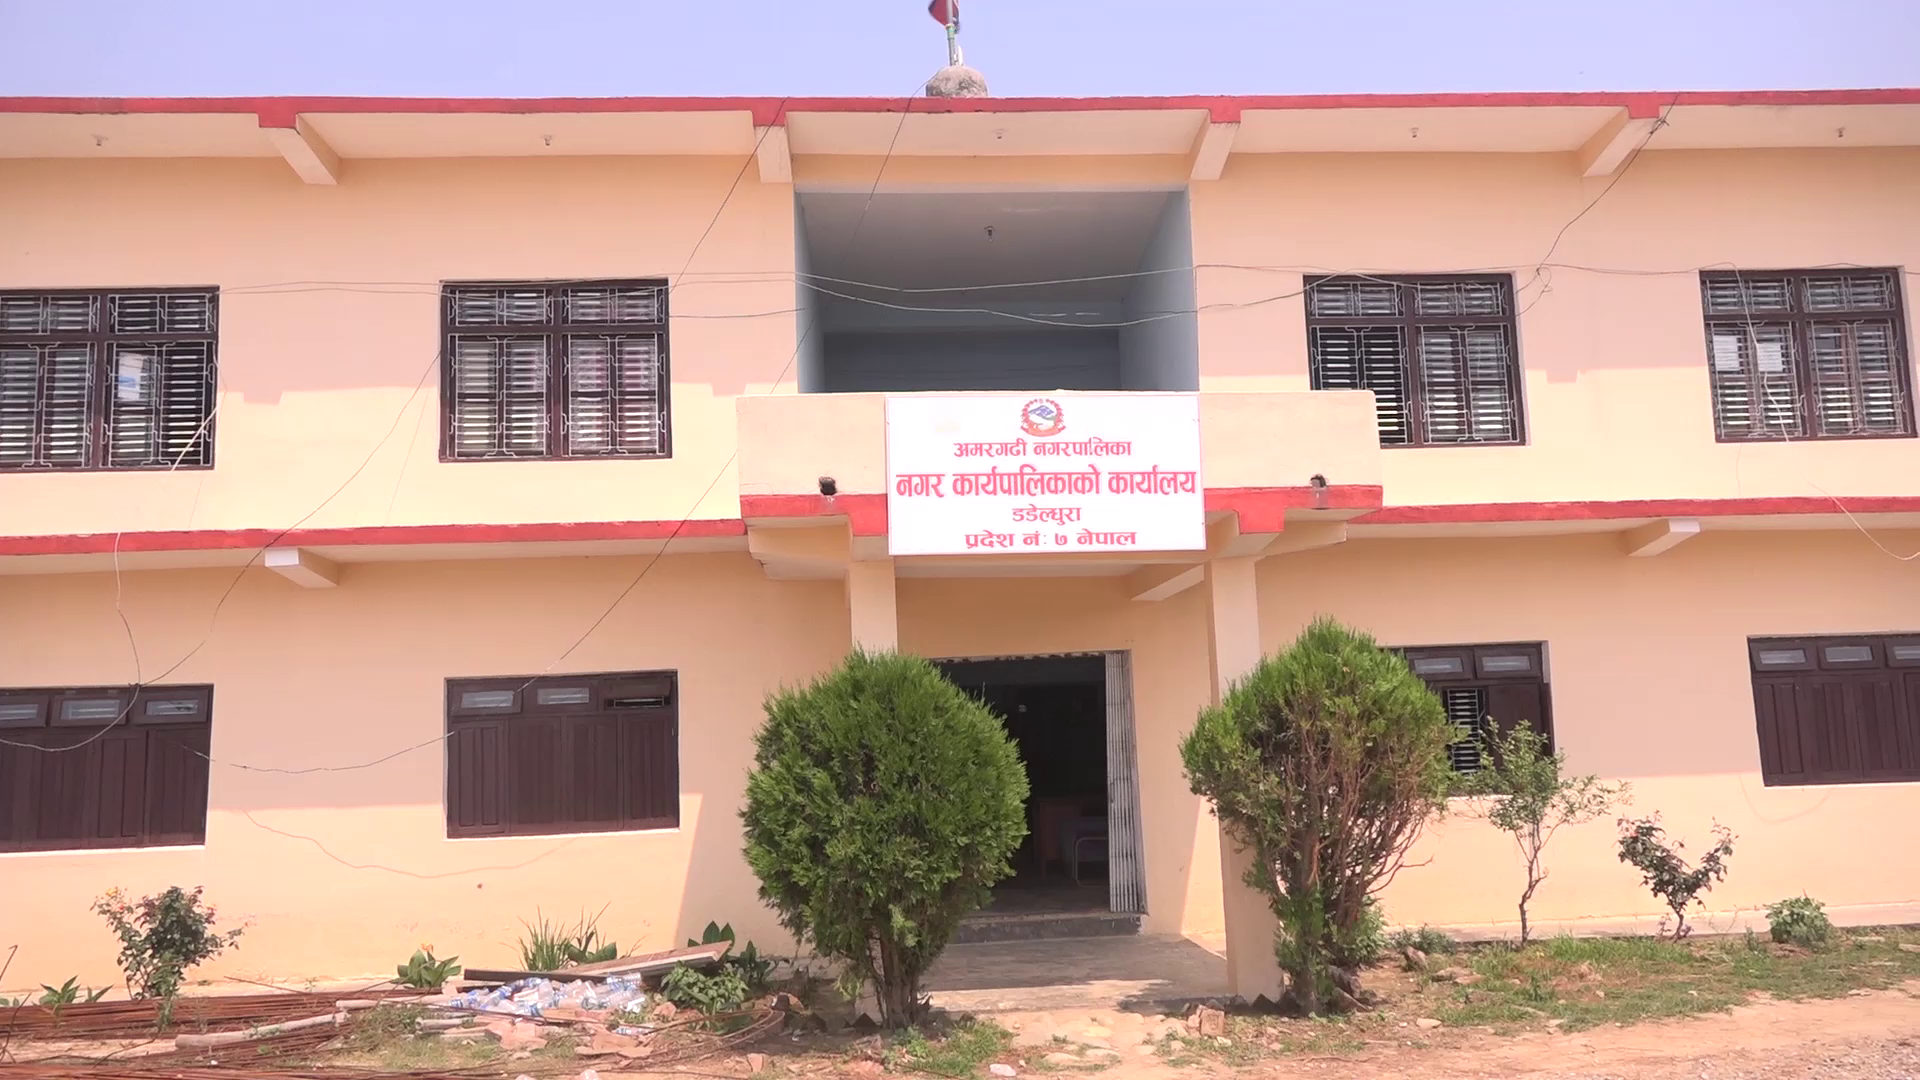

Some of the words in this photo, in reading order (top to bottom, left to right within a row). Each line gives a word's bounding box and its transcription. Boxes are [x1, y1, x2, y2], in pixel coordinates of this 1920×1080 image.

[1033, 436, 1132, 457] नगरपालिका
[896, 473, 945, 498] नगर
[952, 463, 1101, 497] कार्यपालिकाको
[1108, 464, 1197, 496] कार्यालय
[965, 529, 1014, 549] प्रदेश
[1054, 533, 1068, 546] ७
[1077, 528, 1137, 546] नेपाल
